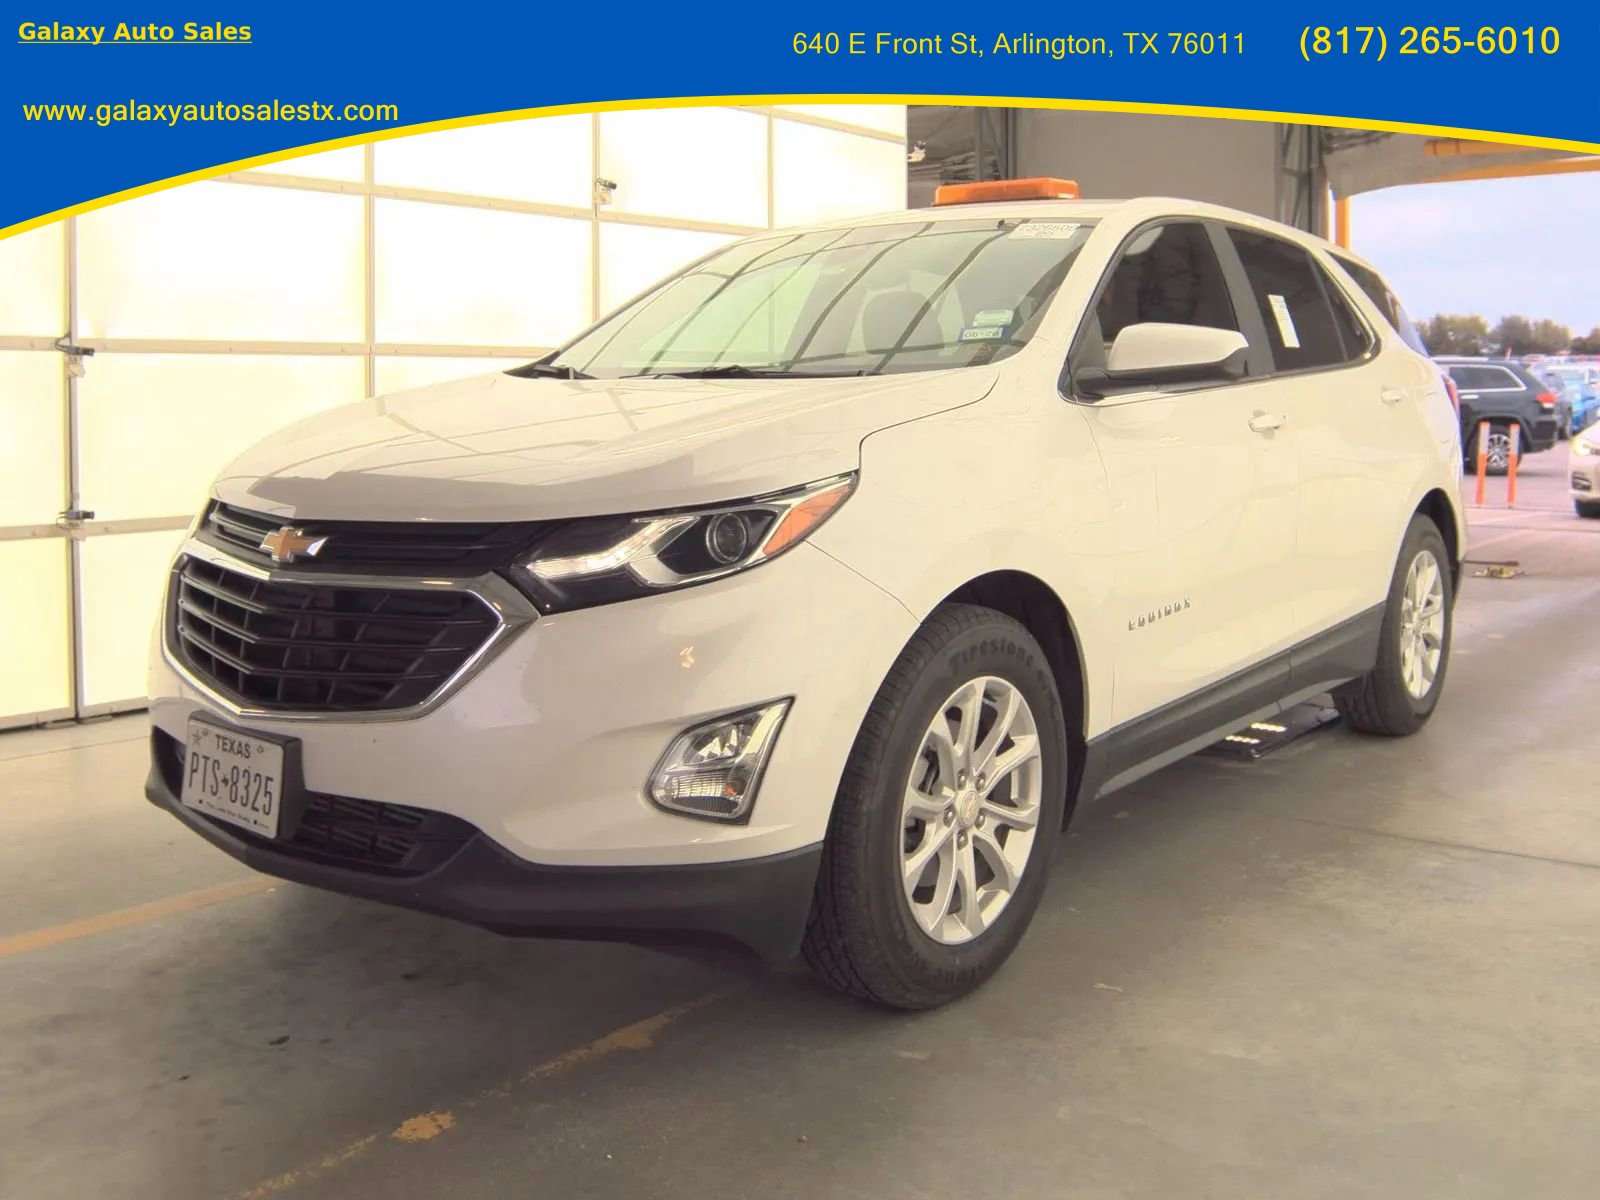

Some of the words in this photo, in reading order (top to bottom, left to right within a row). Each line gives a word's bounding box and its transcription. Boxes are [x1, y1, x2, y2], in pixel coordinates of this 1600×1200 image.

[1127, 597, 1192, 632] EQUINOX
[948, 637, 1035, 677] Firestone
[215, 733, 251, 759] TEXAS
